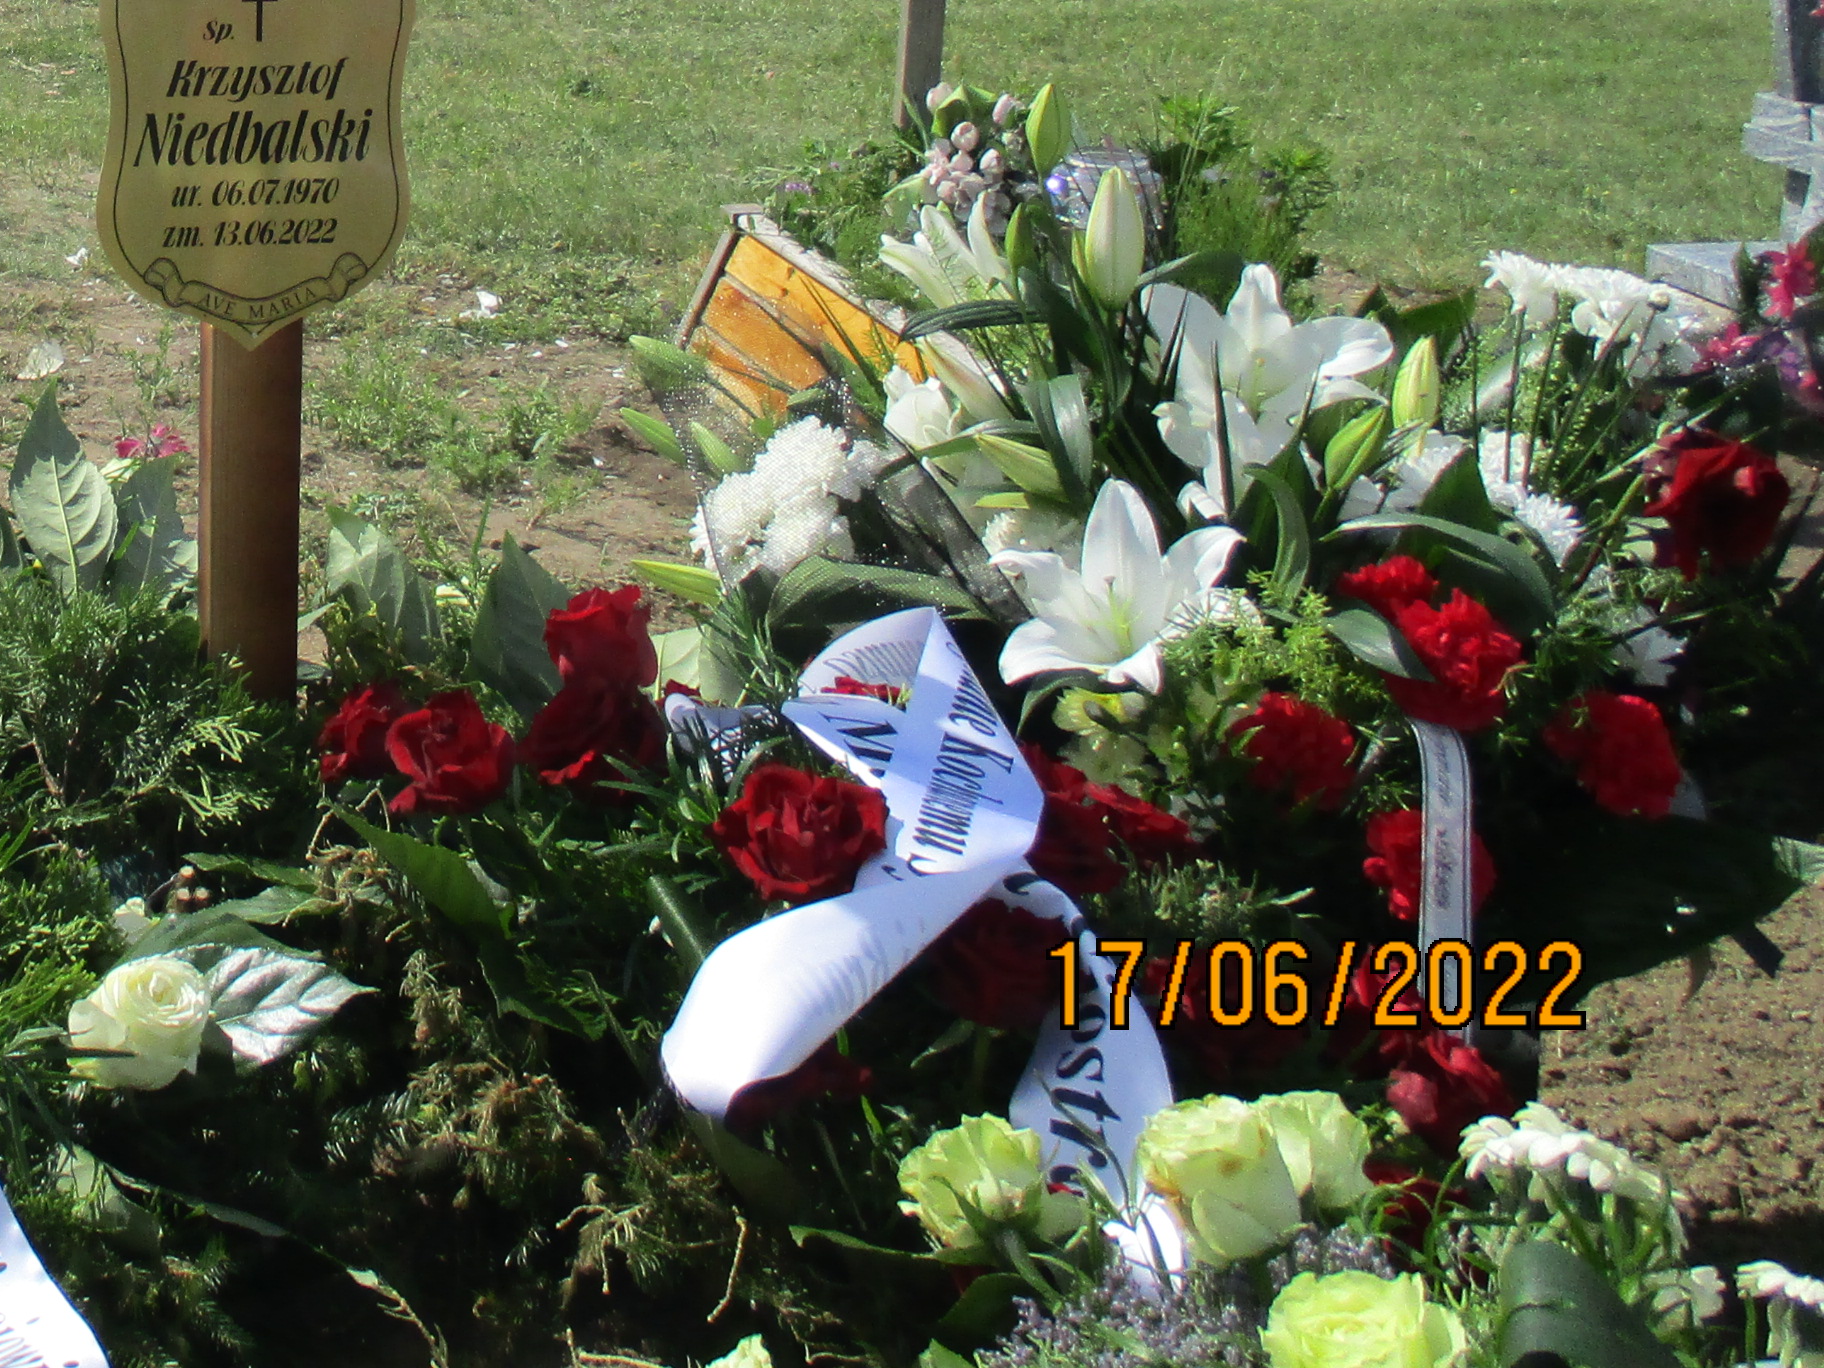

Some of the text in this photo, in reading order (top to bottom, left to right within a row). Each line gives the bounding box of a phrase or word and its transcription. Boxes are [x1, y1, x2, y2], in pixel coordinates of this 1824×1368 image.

[165, 56, 350, 103] Krzysztof
[132, 108, 374, 168] Niedbalski
[170, 177, 340, 208] ur. 06.07.1970
[161, 218, 339, 249] zm. 13.06.2022
[199, 285, 317, 320] AVE MARIA
